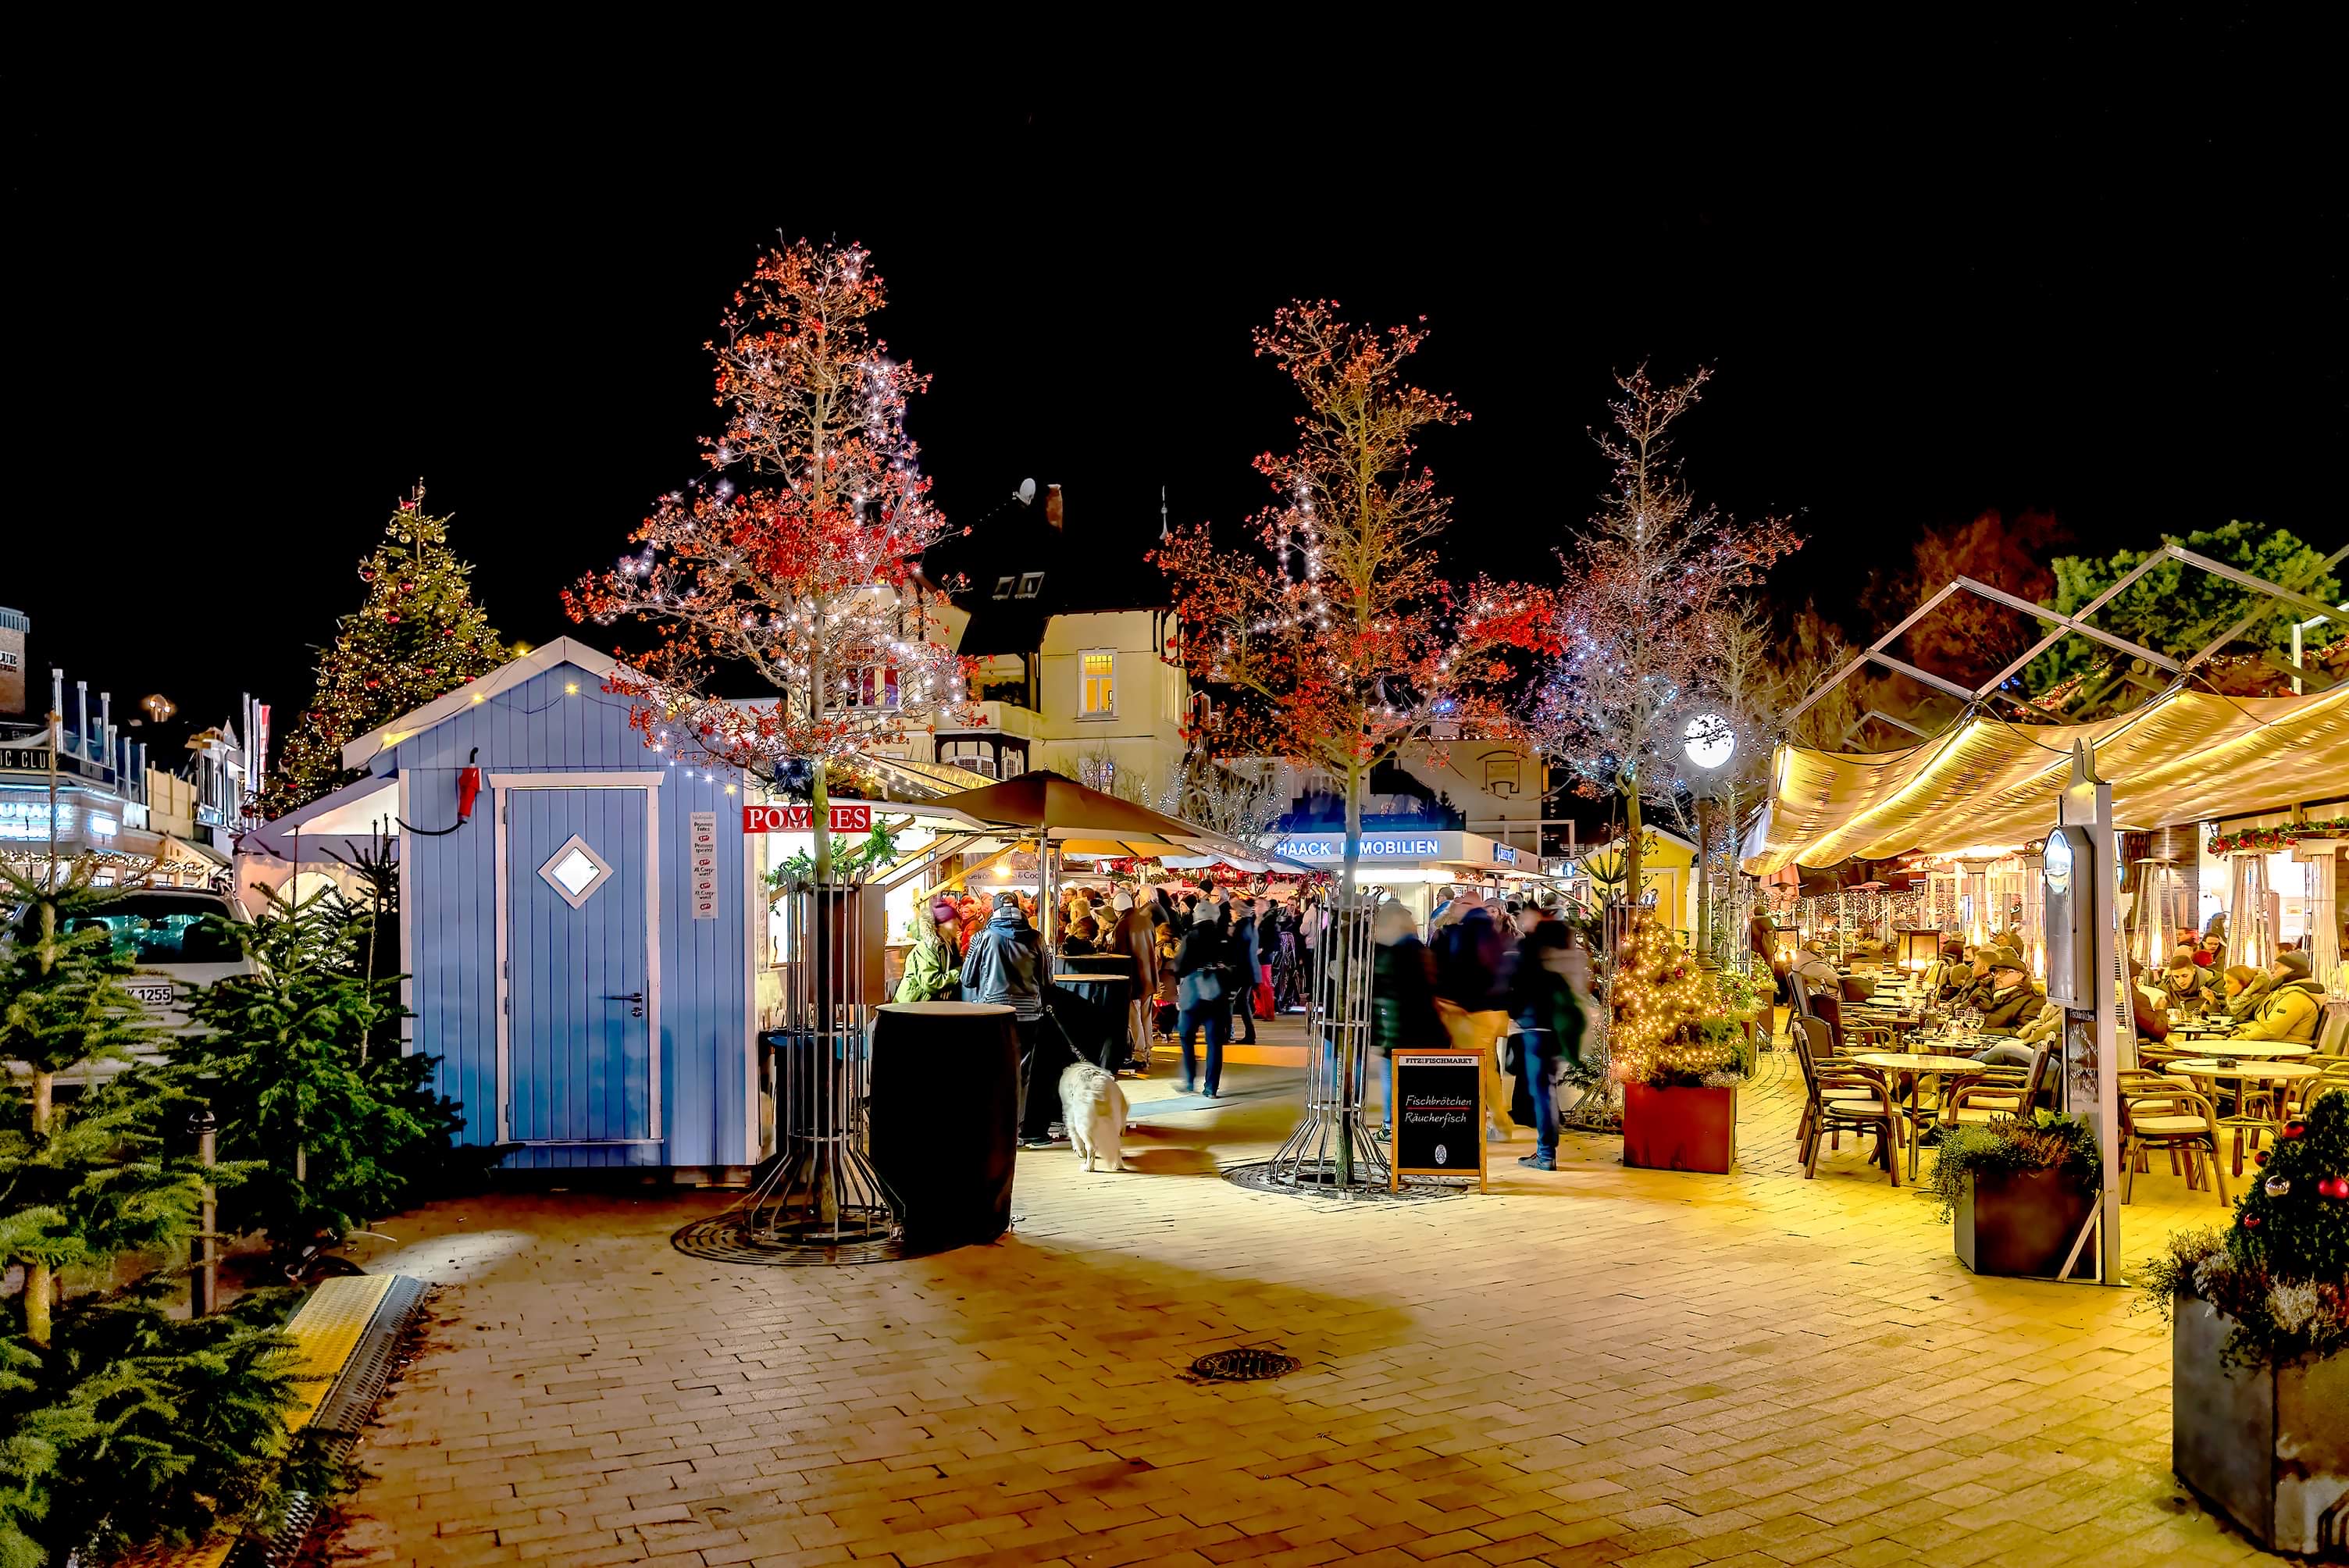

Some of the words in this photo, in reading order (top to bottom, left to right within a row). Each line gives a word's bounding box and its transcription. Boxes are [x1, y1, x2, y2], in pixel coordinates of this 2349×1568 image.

[748, 807, 867, 829] POMES
[1274, 842, 1331, 856] HAACK
[1339, 840, 1438, 855] IMOBILIEN
[138, 989, 170, 1000] 1255
[1406, 1095, 1472, 1106] Fischbrötchen
[1405, 1112, 1467, 1128] Räucherfisch
